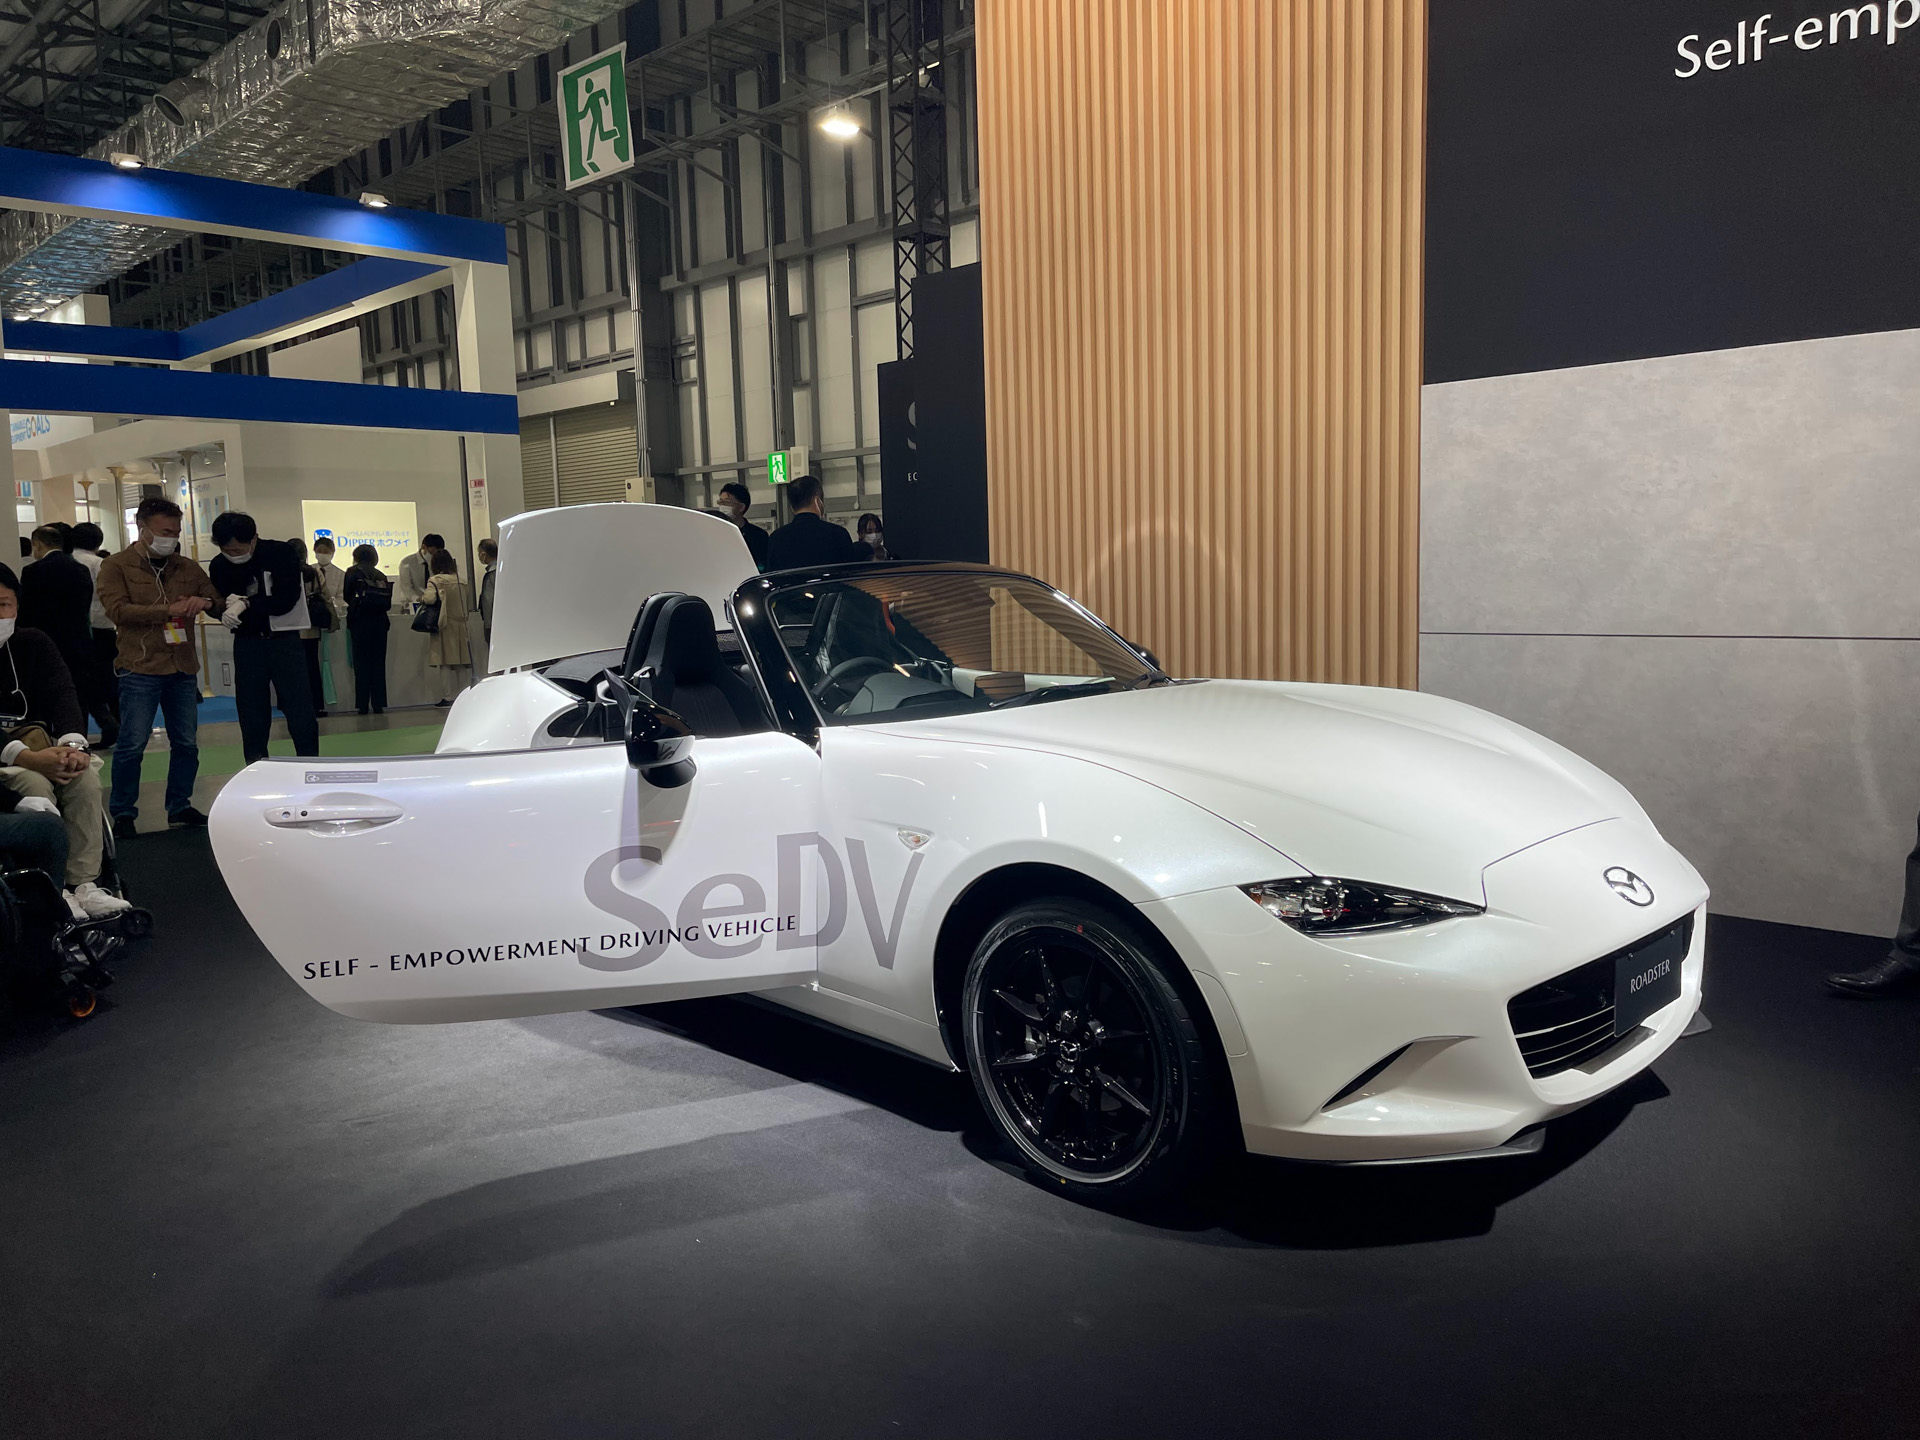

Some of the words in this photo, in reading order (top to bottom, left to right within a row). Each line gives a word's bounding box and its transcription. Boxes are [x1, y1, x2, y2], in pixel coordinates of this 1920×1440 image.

[1674, 0, 1920, 78] Self-emp
[26, 414, 50, 439] GOALS
[337, 536, 375, 548] DIPPER
[377, 538, 410, 547] ホクメイ
[576, 831, 925, 972] SeDV
[303, 958, 359, 980] SELF
[390, 936, 591, 971] EMPOWERMENT
[600, 925, 699, 951] DRIVING
[708, 915, 796, 939] VEHICLE
[1630, 959, 1671, 994] ROADSTER
